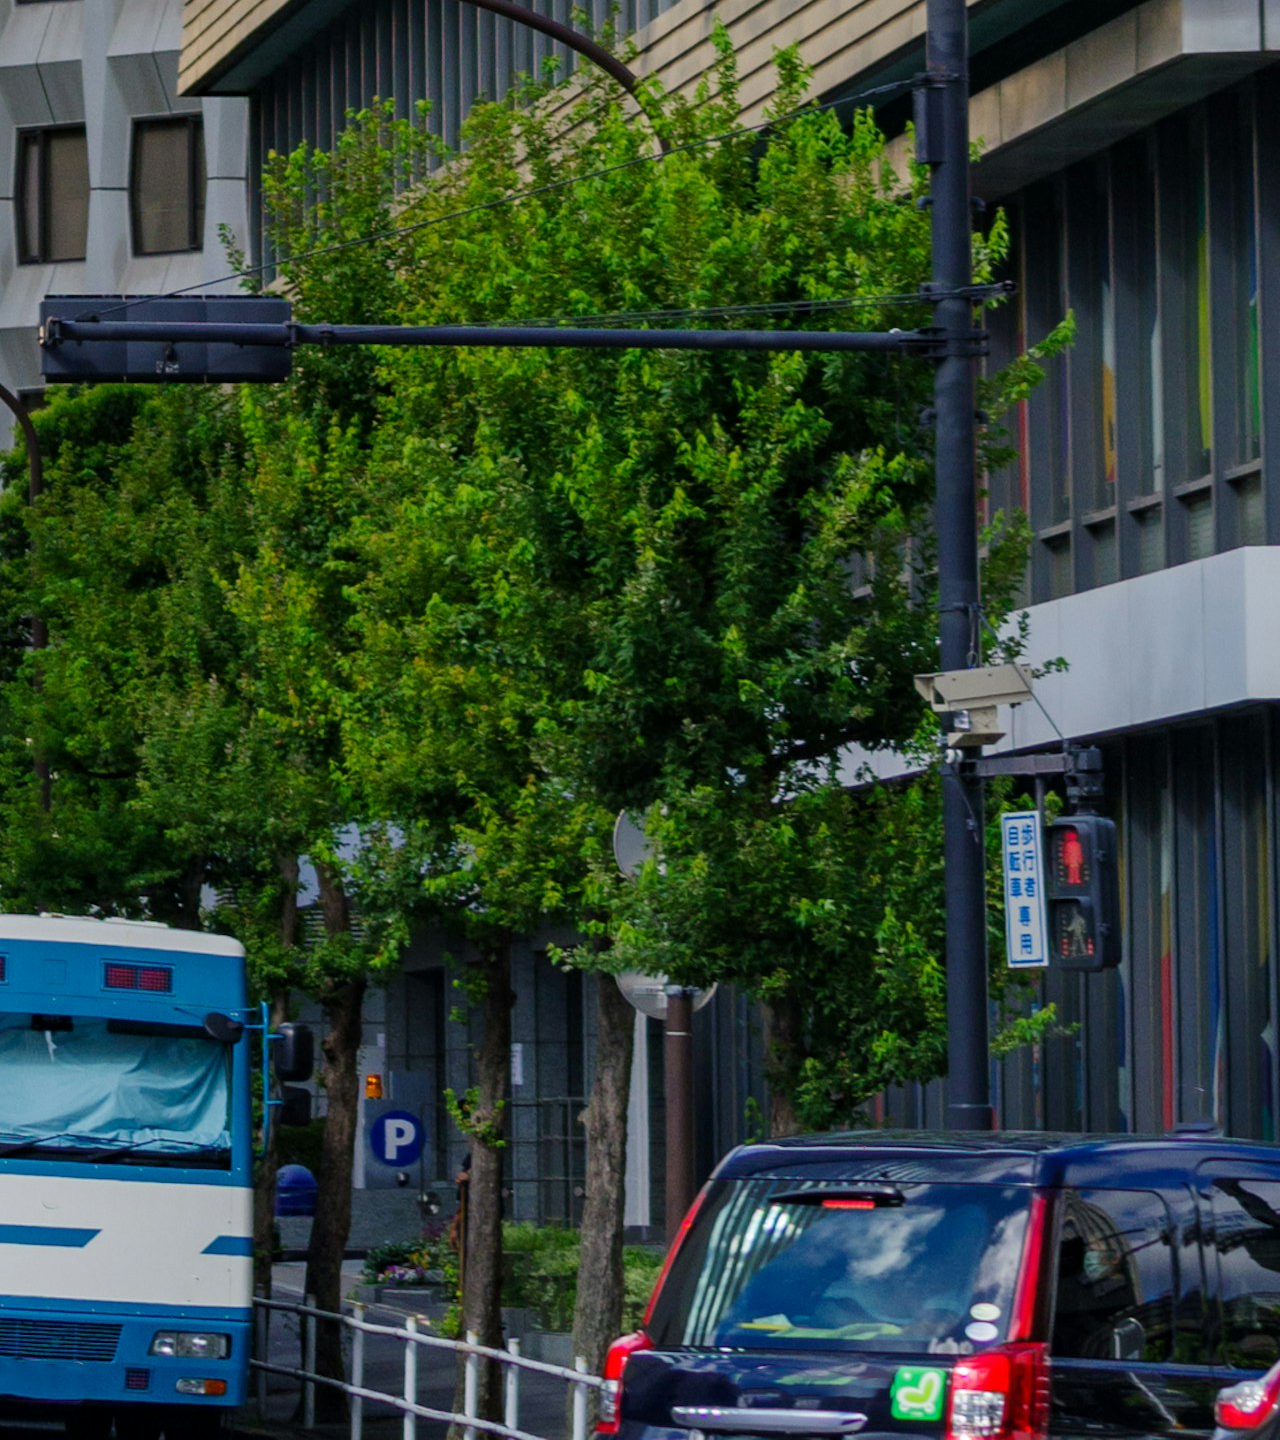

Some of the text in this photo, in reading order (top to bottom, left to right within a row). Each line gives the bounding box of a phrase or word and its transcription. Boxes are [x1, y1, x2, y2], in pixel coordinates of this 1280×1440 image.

[1008, 826, 1022, 898] 自転車
[1021, 824, 1036, 897] 歩行者
[1018, 905, 1033, 955] 専用
[385, 1119, 416, 1159] P
